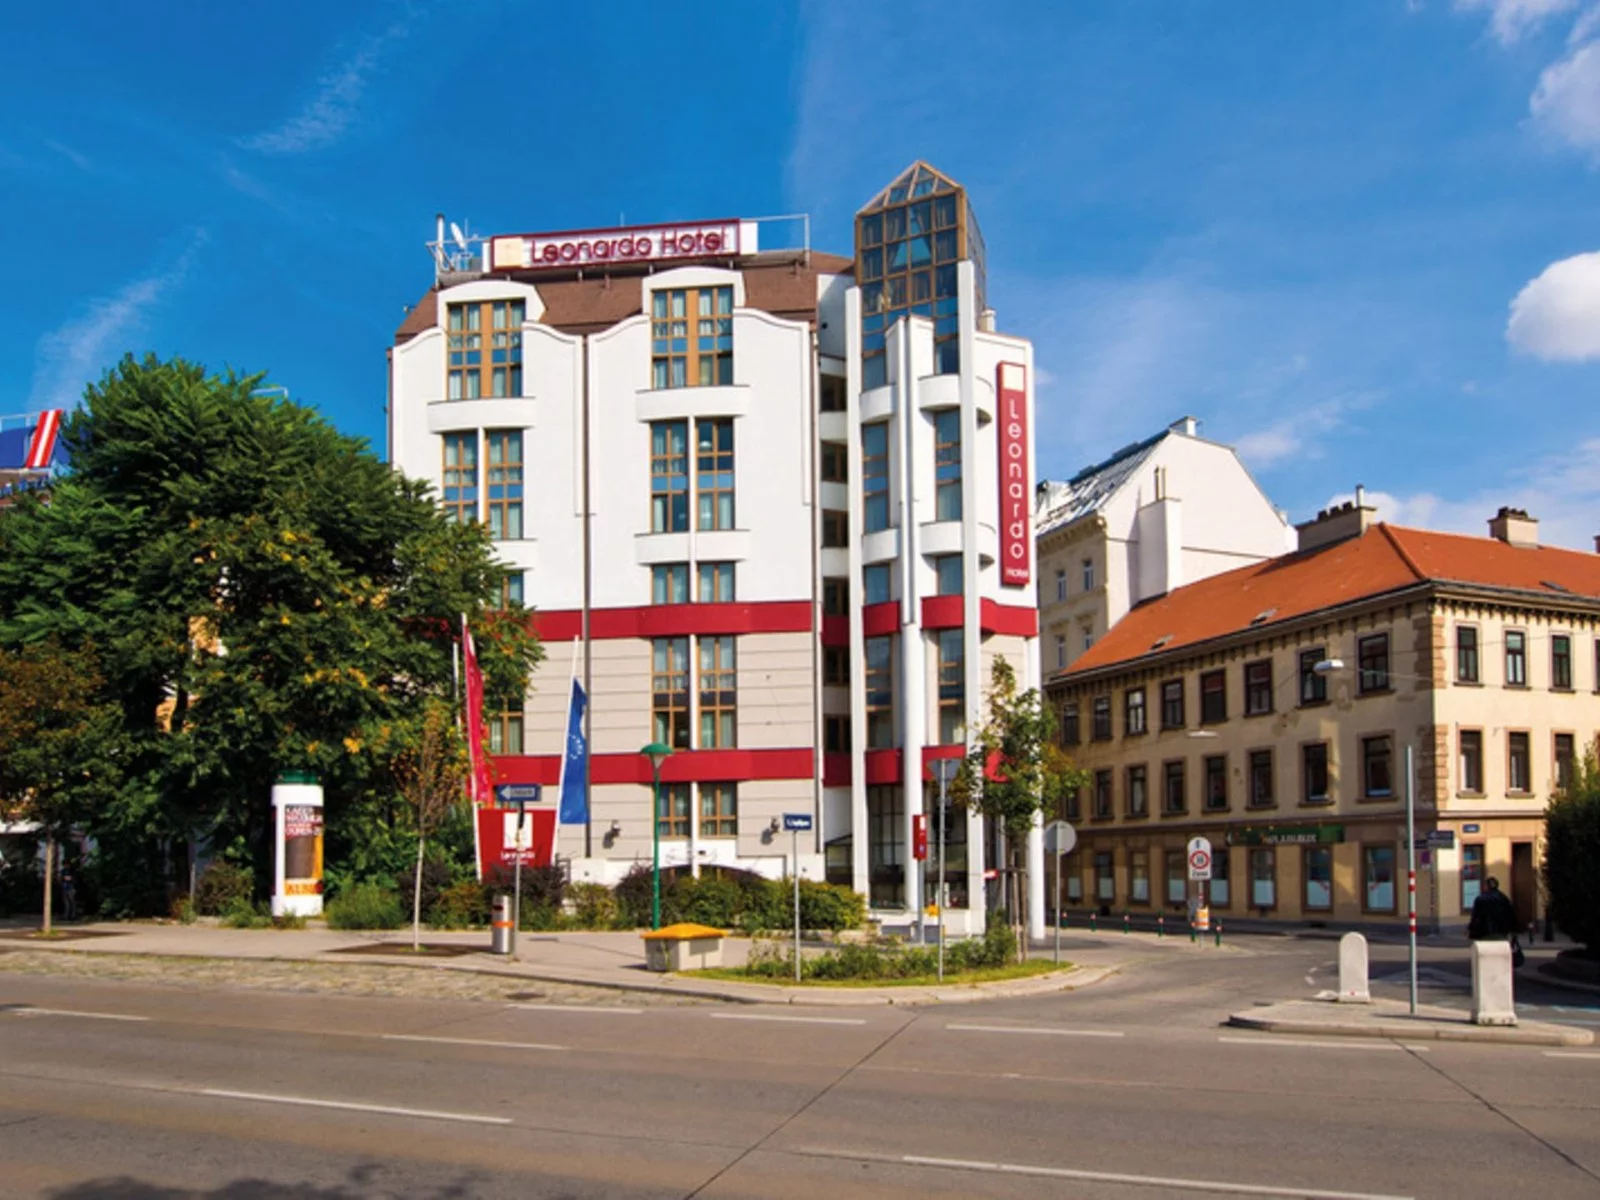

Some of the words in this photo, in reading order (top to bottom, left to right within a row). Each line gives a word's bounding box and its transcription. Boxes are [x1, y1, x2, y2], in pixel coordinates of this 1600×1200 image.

[530, 232, 653, 264] Leonardo
[660, 224, 726, 257] Hotel
[1007, 398, 1024, 560] Leonardo
